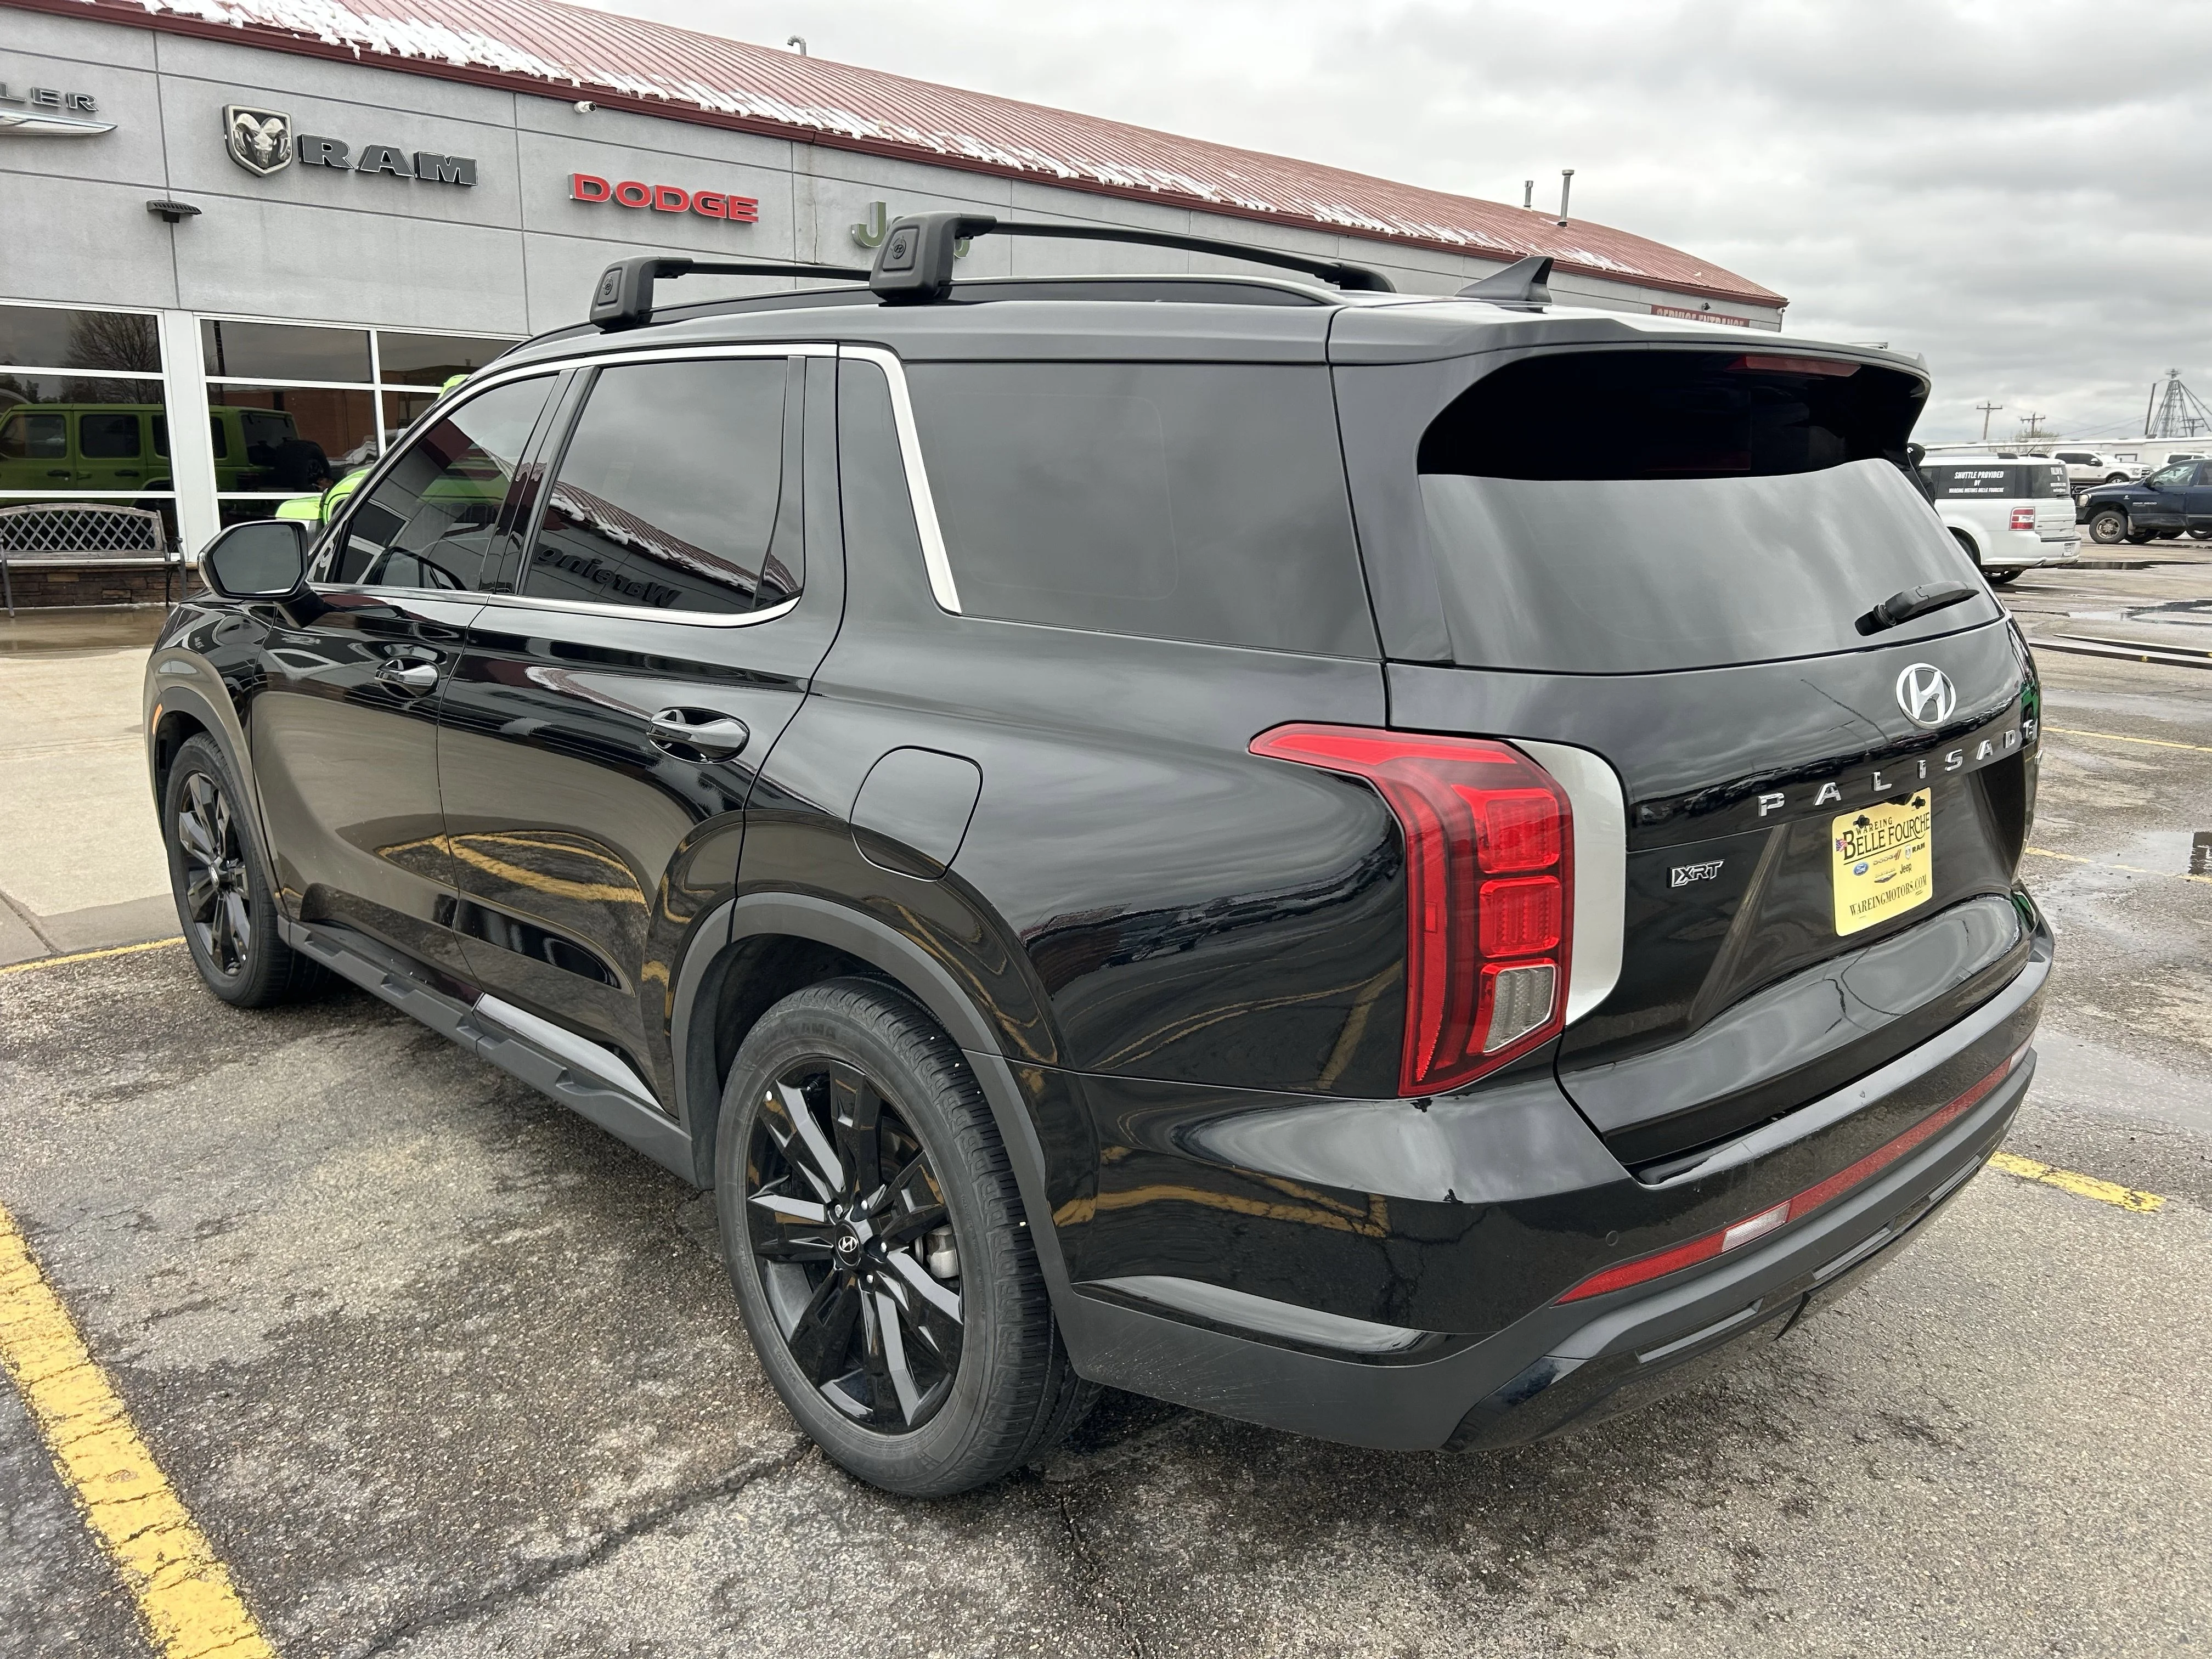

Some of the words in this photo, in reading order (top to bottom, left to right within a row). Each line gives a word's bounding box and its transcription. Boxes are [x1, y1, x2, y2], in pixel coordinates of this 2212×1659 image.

[297, 134, 479, 187] RAM
[568, 173, 759, 223] DODGE
[1954, 471, 1978, 479] SHUTTLE
[1977, 471, 2004, 479] PROVIDED
[1758, 719, 2034, 816] PALISADE
[1843, 829, 1886, 860] BELLE
[1888, 812, 1929, 845] FOURCHE
[1855, 816, 1893, 836] WAREING
[1912, 842, 1926, 853] RAM
[1669, 860, 1724, 887] XRT
[1900, 863, 1912, 874] Jeep
[1849, 874, 1927, 916] WAREINGMOTORS.COM
